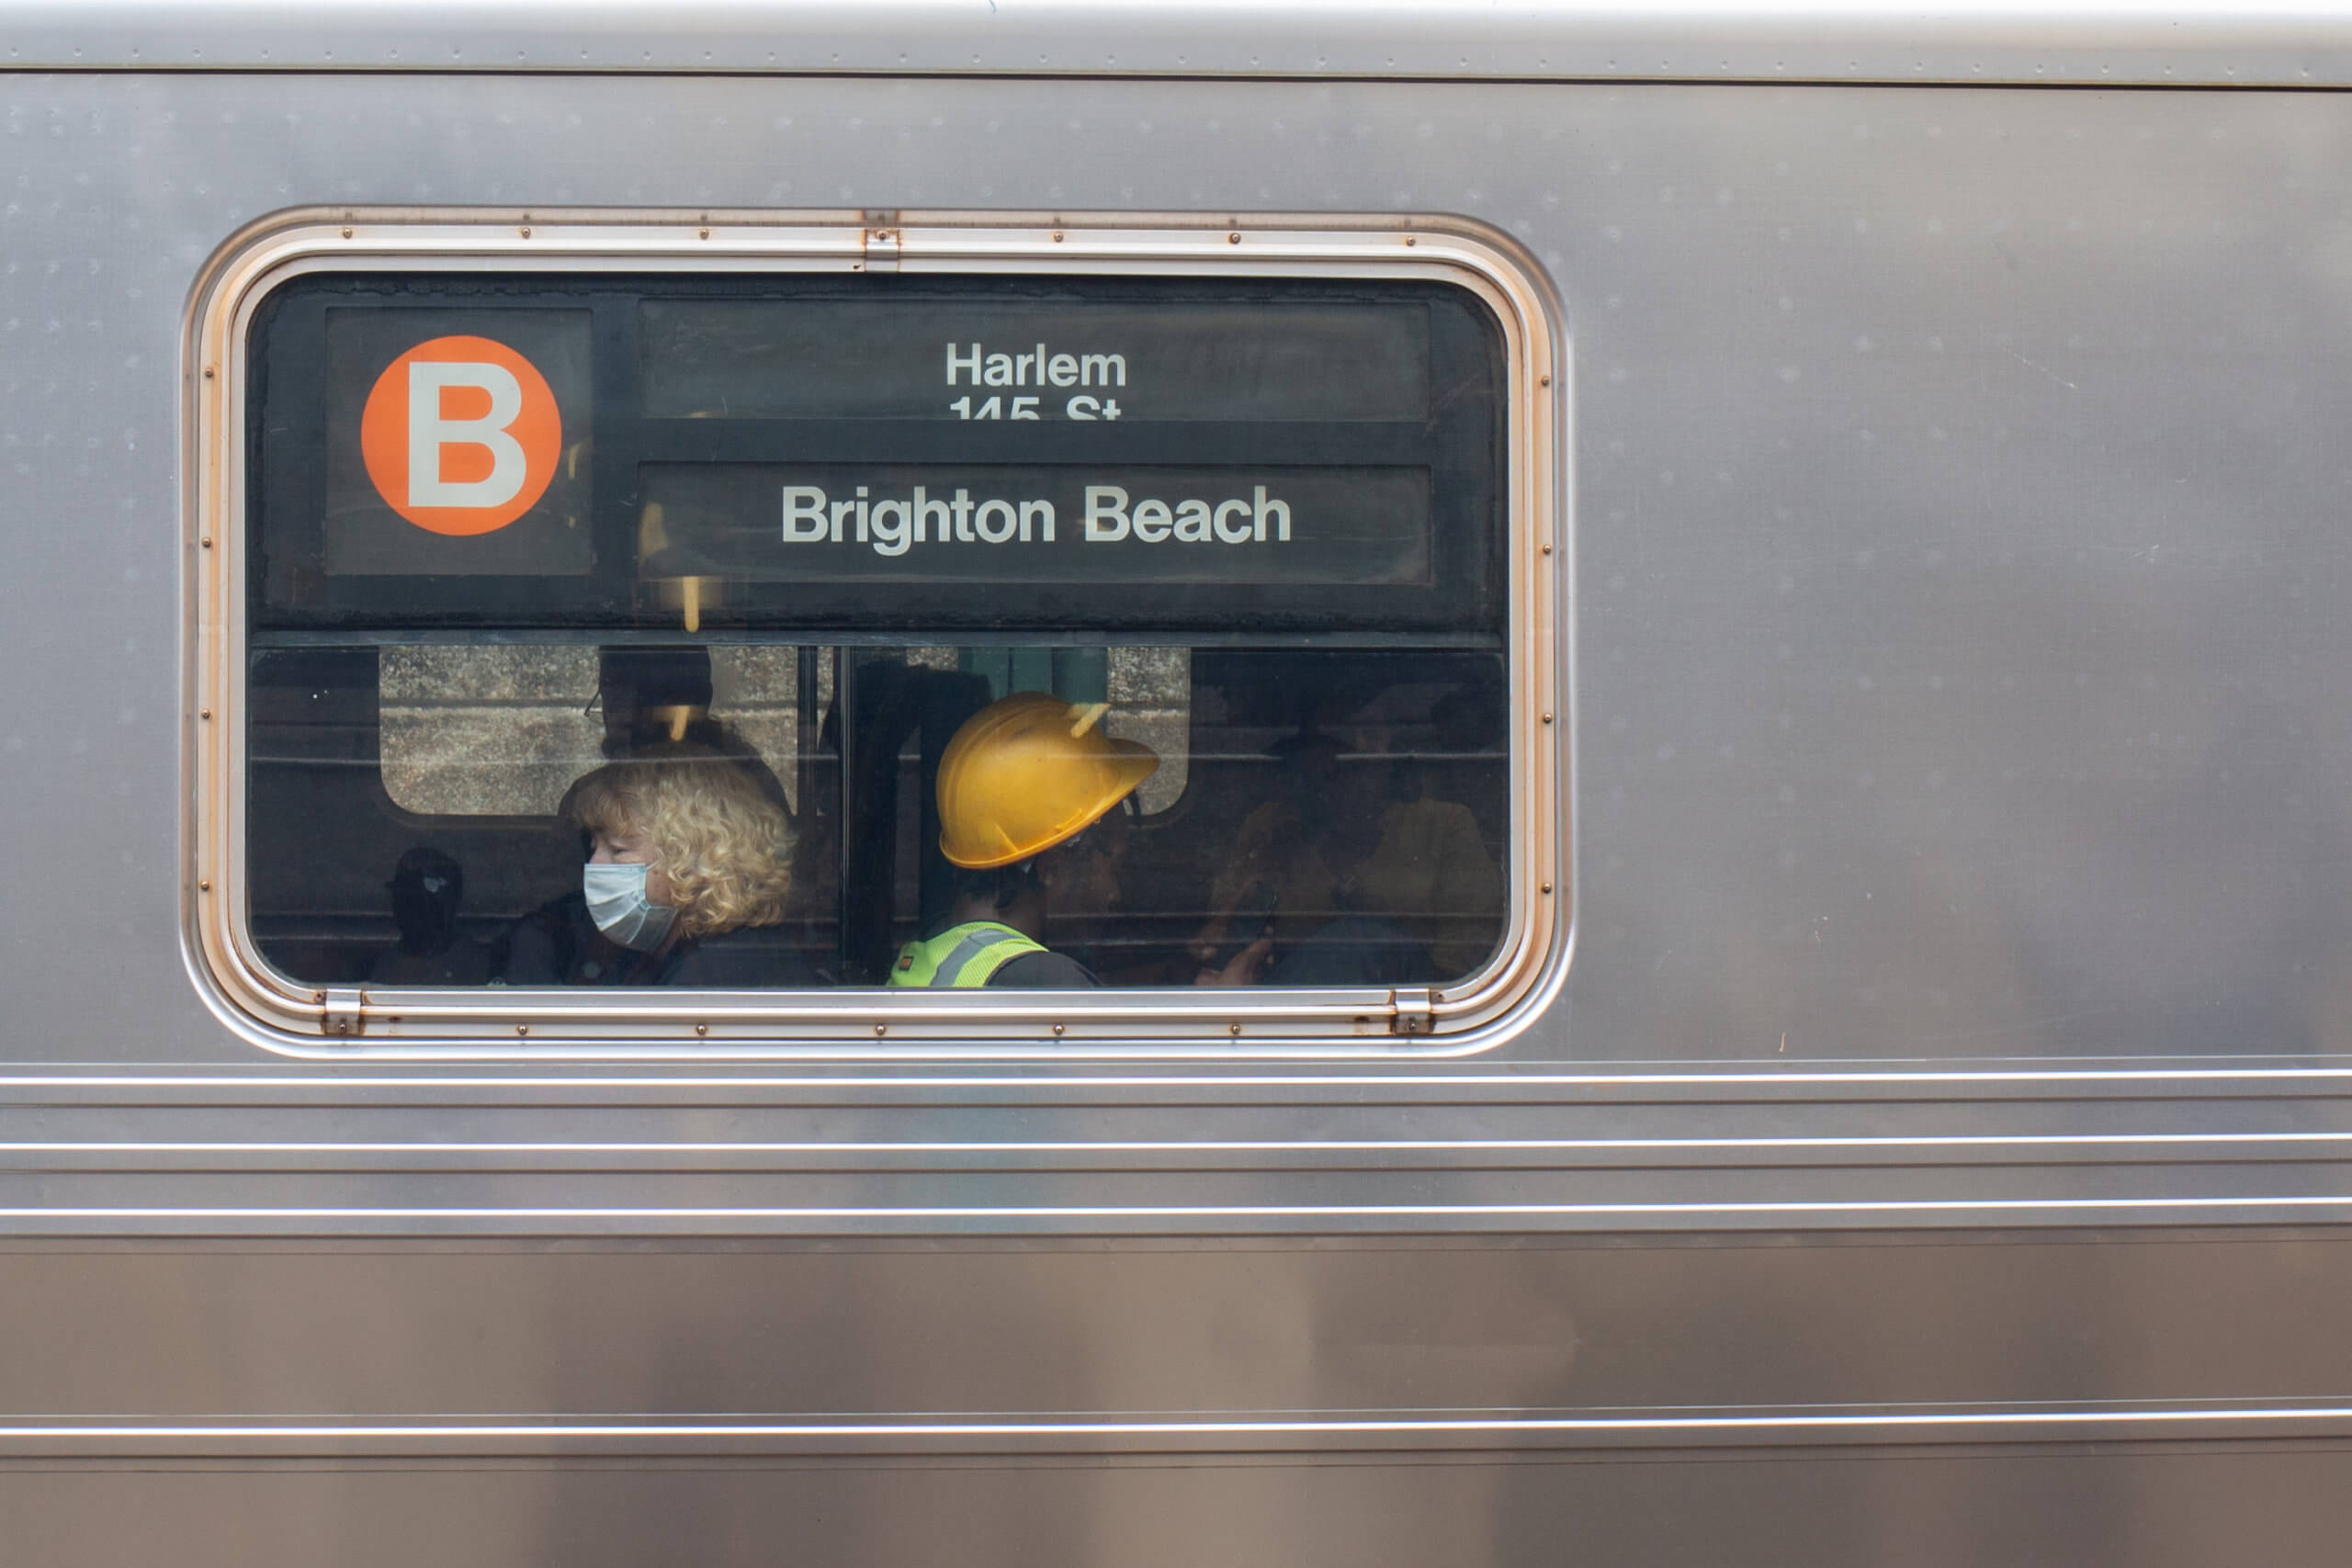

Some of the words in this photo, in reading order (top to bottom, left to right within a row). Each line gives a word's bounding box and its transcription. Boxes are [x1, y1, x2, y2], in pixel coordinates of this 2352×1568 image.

[946, 343, 1126, 387] Harlem
[407, 360, 527, 508] B
[782, 485, 1056, 557] Brighton
[1084, 485, 1291, 545] Beach
